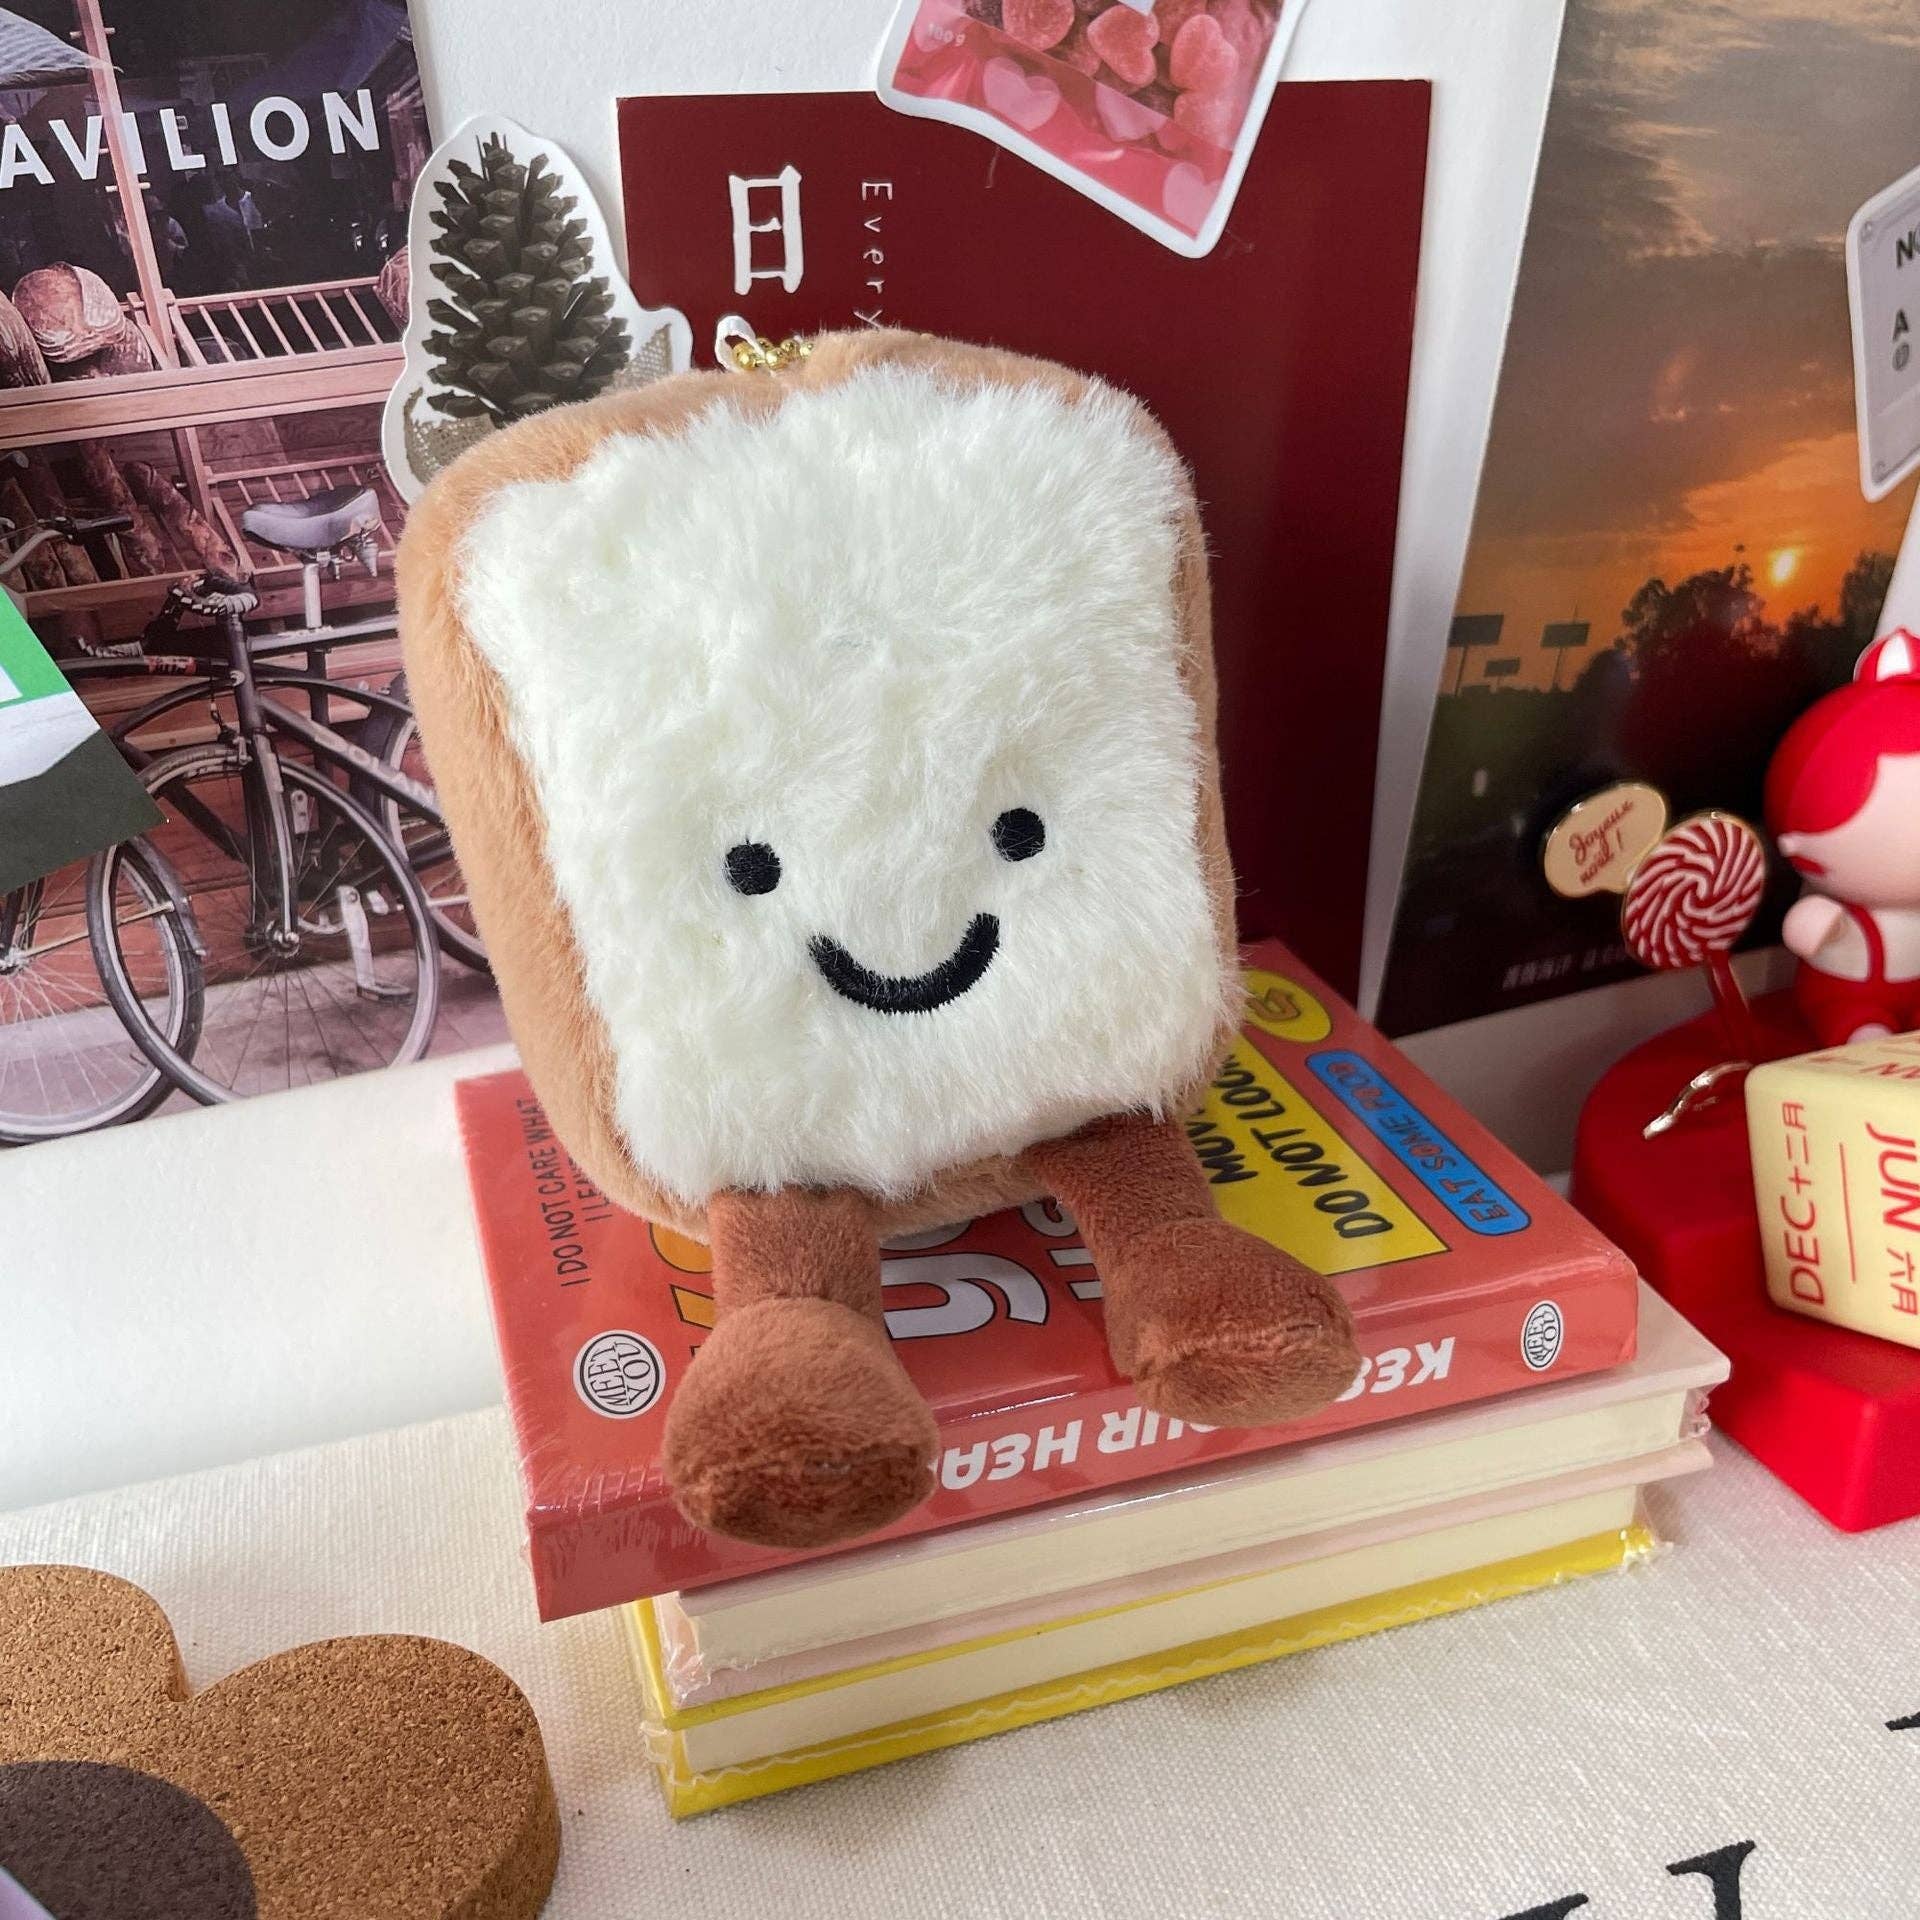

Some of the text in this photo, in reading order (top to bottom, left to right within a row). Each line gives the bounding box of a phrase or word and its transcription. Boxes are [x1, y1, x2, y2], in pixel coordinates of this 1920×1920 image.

[852, 181, 893, 329] Every
[1569, 800, 1634, 867] Joyeux
[528, 1148, 567, 1195] CARE
[1251, 1127, 1349, 1187] NOT
[1376, 1112, 1457, 1172] SOME
[1438, 1177, 1510, 1223] EAT
[1866, 1122, 1920, 1233] JUN
[541, 1199, 580, 1240] NOT
[1313, 1189, 1394, 1239] DO
[553, 1243, 589, 1275] DO
[1780, 1195, 1825, 1305] DEC
[560, 1277, 592, 1287] I
[588, 1344, 630, 1406] MEET
[614, 1341, 651, 1405] YOU
